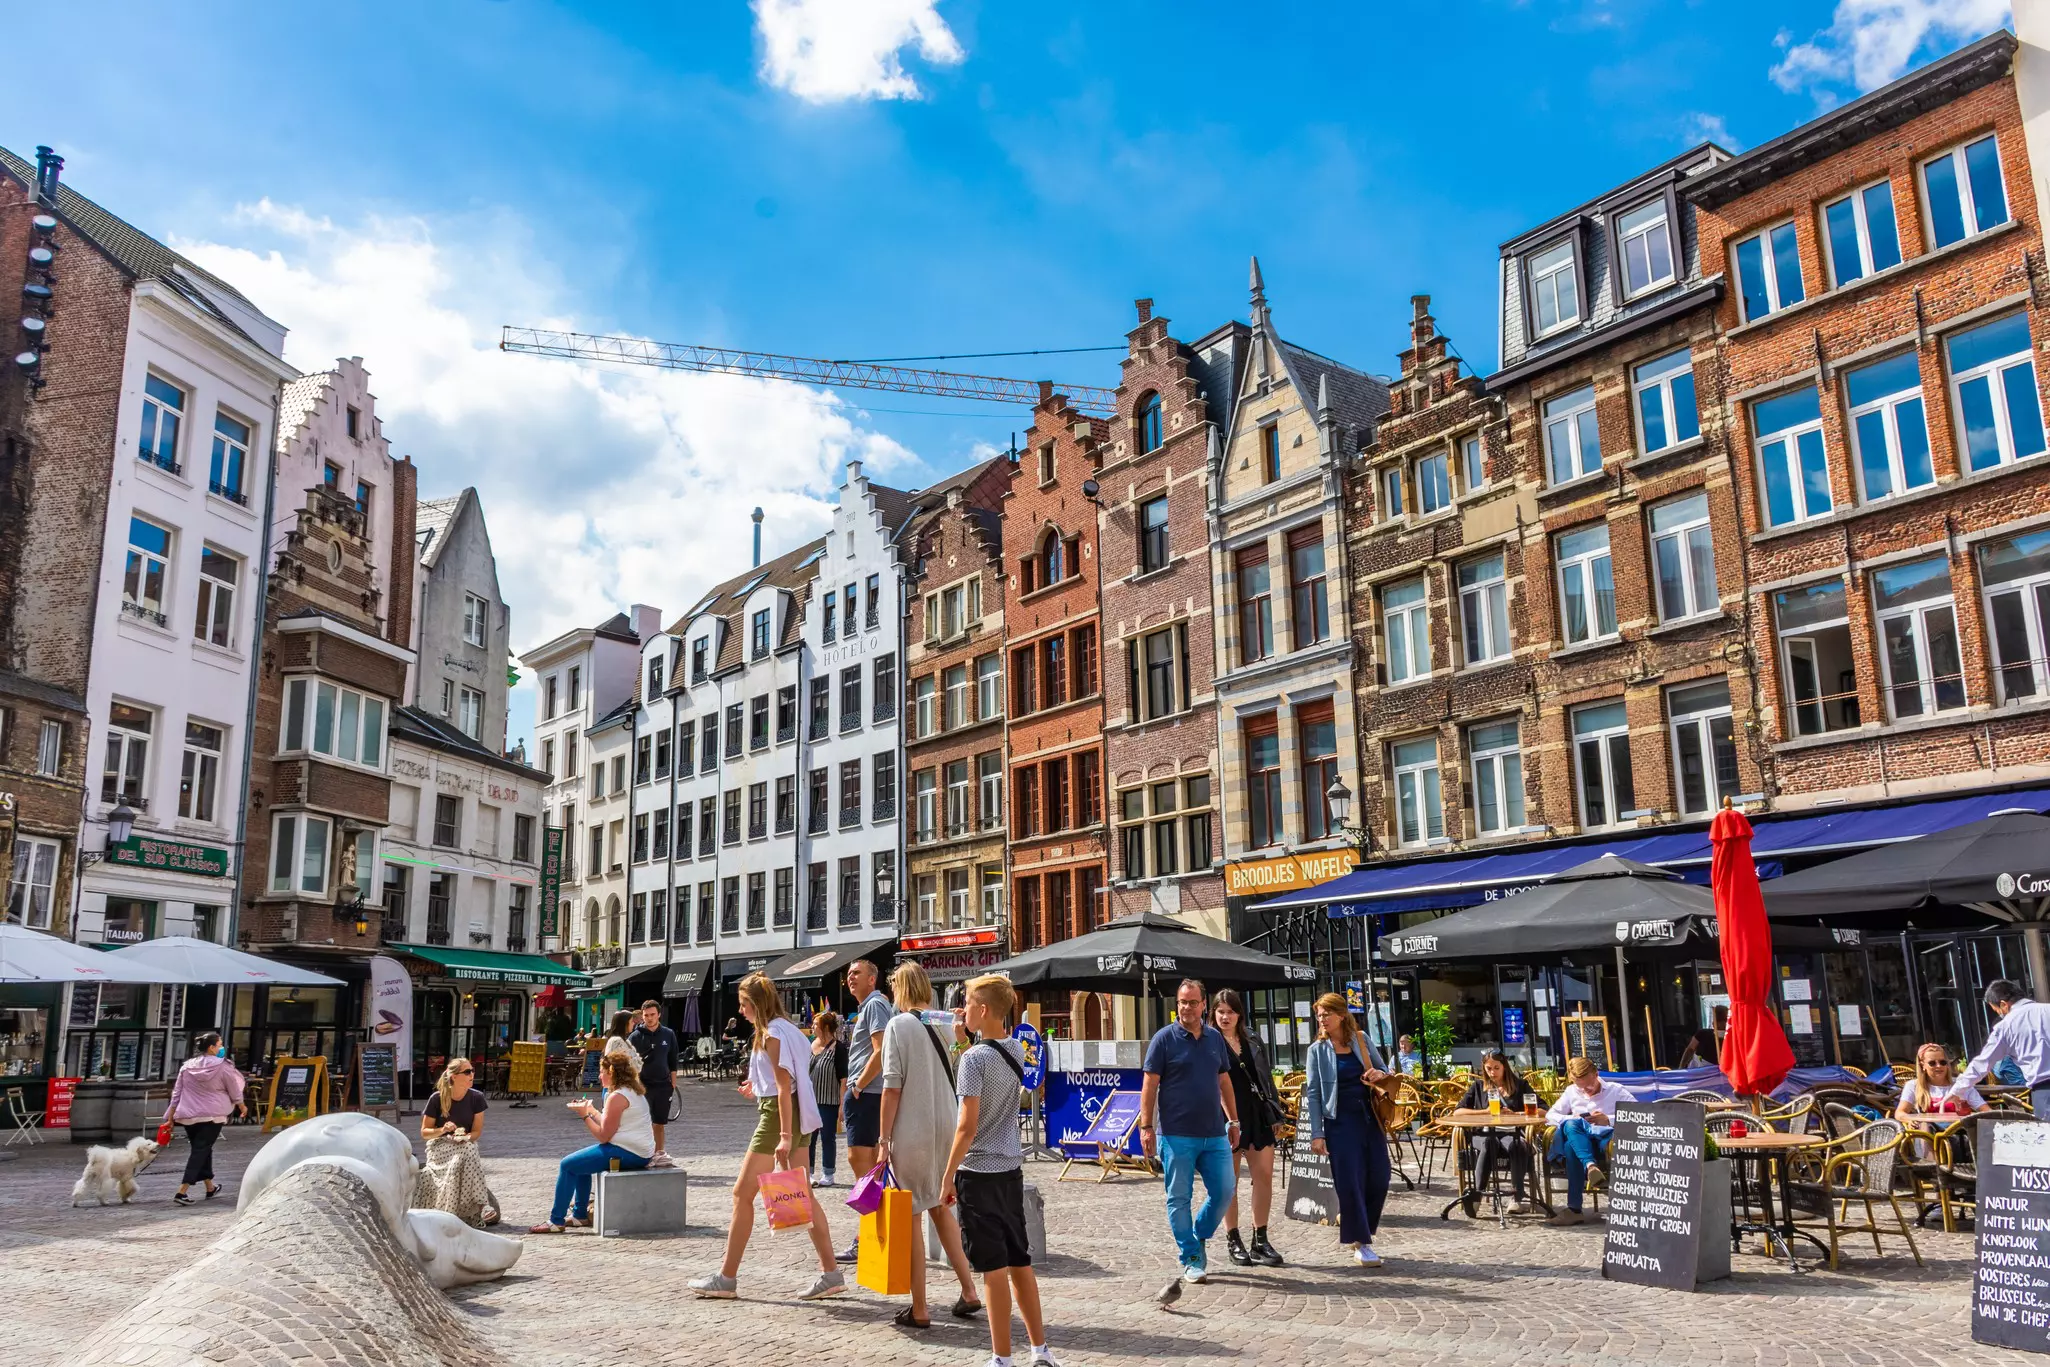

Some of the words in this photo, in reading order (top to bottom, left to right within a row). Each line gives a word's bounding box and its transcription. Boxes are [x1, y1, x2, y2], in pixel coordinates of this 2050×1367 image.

[824, 636, 866, 667] HOTEL
[504, 786, 519, 803] SUD
[140, 840, 204, 860] RISTORANTE
[548, 831, 560, 852] DEL
[117, 849, 139, 861] DEL
[144, 853, 166, 865] SUD
[169, 856, 221, 872] CLASSICO
[546, 854, 559, 875] SUD
[1232, 862, 1295, 889] BROODJES
[1301, 854, 1353, 881] WAFELS
[2017, 873, 2050, 893] Cors
[542, 877, 557, 932] CLASSICO
[1484, 889, 1498, 901] DE
[105, 929, 144, 941] ITALIANO
[1632, 921, 1675, 940] CORNET
[1404, 936, 1438, 953] CORNET
[922, 952, 974, 970] SPARKLING
[1153, 957, 1177, 970] CORNET
[455, 969, 499, 980] RISTORANTE
[504, 973, 533, 983] PIZZERIA
[537, 975, 547, 984] Del
[550, 976, 561, 985] Sud
[565, 977, 587, 987] Classico
[1292, 967, 1316, 979] CORNET
[1066, 1069, 1121, 1087] Noordzee
[1616, 1109, 1655, 1124] BELGISCHE
[1637, 1126, 1684, 1139] GERECHTEN
[1618, 1139, 1648, 1152] WITLOOF
[1652, 1142, 1660, 1154] IN
[1661, 1142, 1672, 1156] DE
[1675, 1144, 1698, 1159] OVEN
[1616, 1154, 1631, 1166] VOL
[1632, 1155, 1643, 1167] AU
[1647, 1156, 1671, 1170] VENT
[1615, 1167, 1650, 1184] VLAAMSE
[1652, 1171, 1690, 1189] STOVERIJ
[1611, 1197, 1637, 1212] GENTSE
[1641, 1200, 1681, 1219] WATERZOOI
[1985, 1195, 2029, 1212] NATUUR
[1610, 1213, 1638, 1228] PALING
[1659, 1219, 1691, 1236] GROEN
[1984, 1214, 2016, 1230] WITTE
[2021, 1217, 2050, 1232] WIJN
[1609, 1229, 1639, 1248] FOREL
[1982, 1233, 2038, 1251] KNOFLOOK
[1606, 1251, 1662, 1273] CHIPOLATTA
[1980, 1285, 2037, 1307] BRUSSELSE
[1979, 1303, 2000, 1319] VAN
[2003, 1307, 2018, 1323] DE
[2021, 1310, 2048, 1328] CHEF
